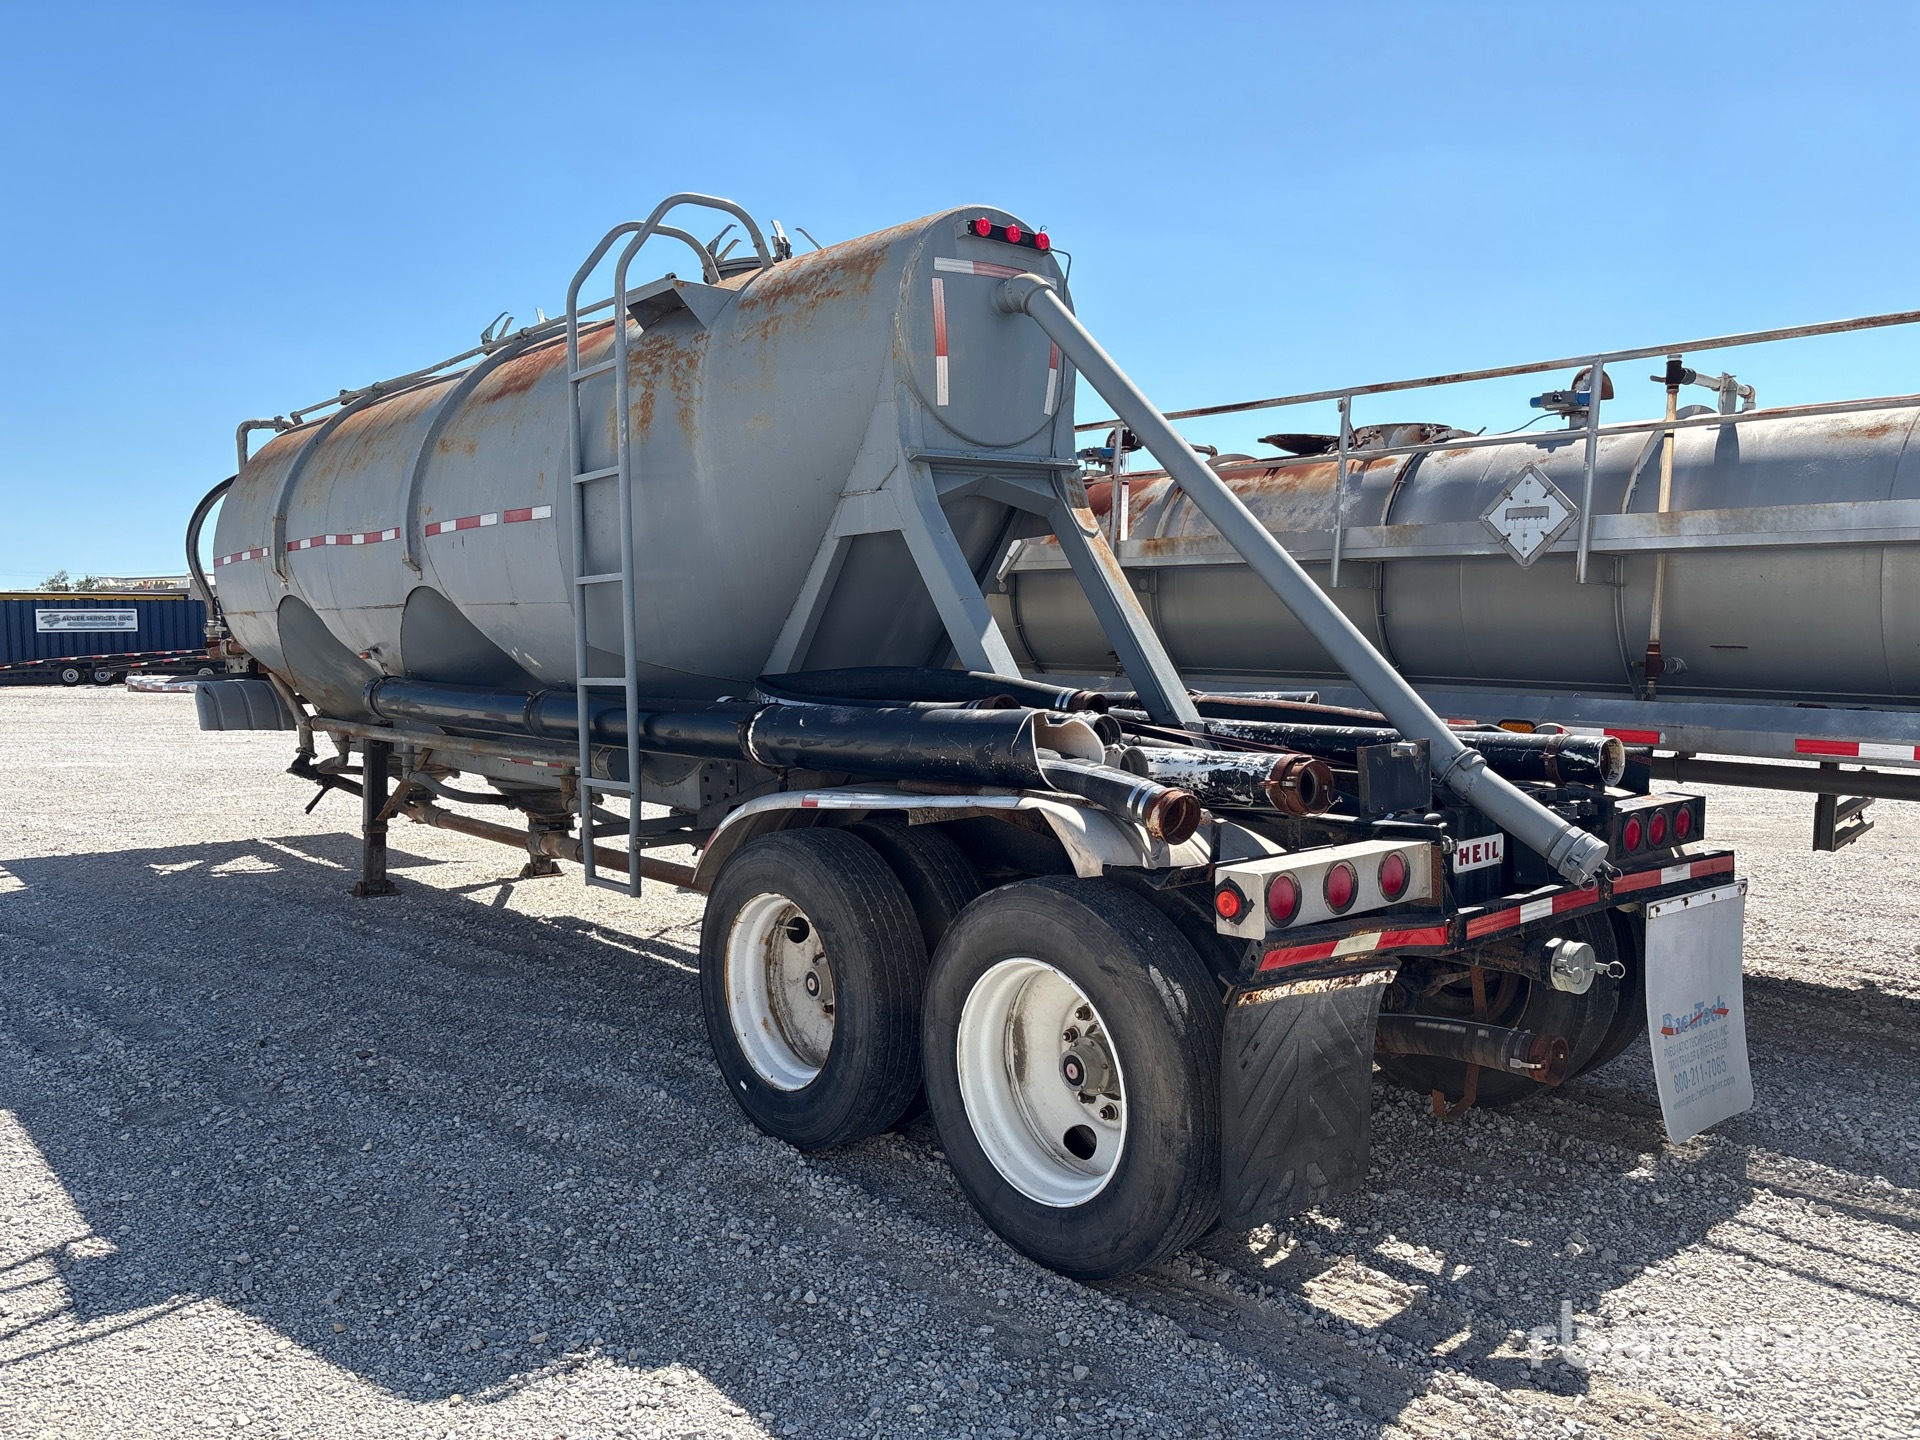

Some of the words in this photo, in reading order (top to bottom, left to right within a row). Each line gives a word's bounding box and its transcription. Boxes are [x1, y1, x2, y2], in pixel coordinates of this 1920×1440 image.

[1458, 841, 1499, 866] HEIL
[1662, 995, 1726, 1040] PneuTech
[1714, 1038, 1728, 1052] SALES
[1673, 1055, 1727, 1094] 800-211-7085
